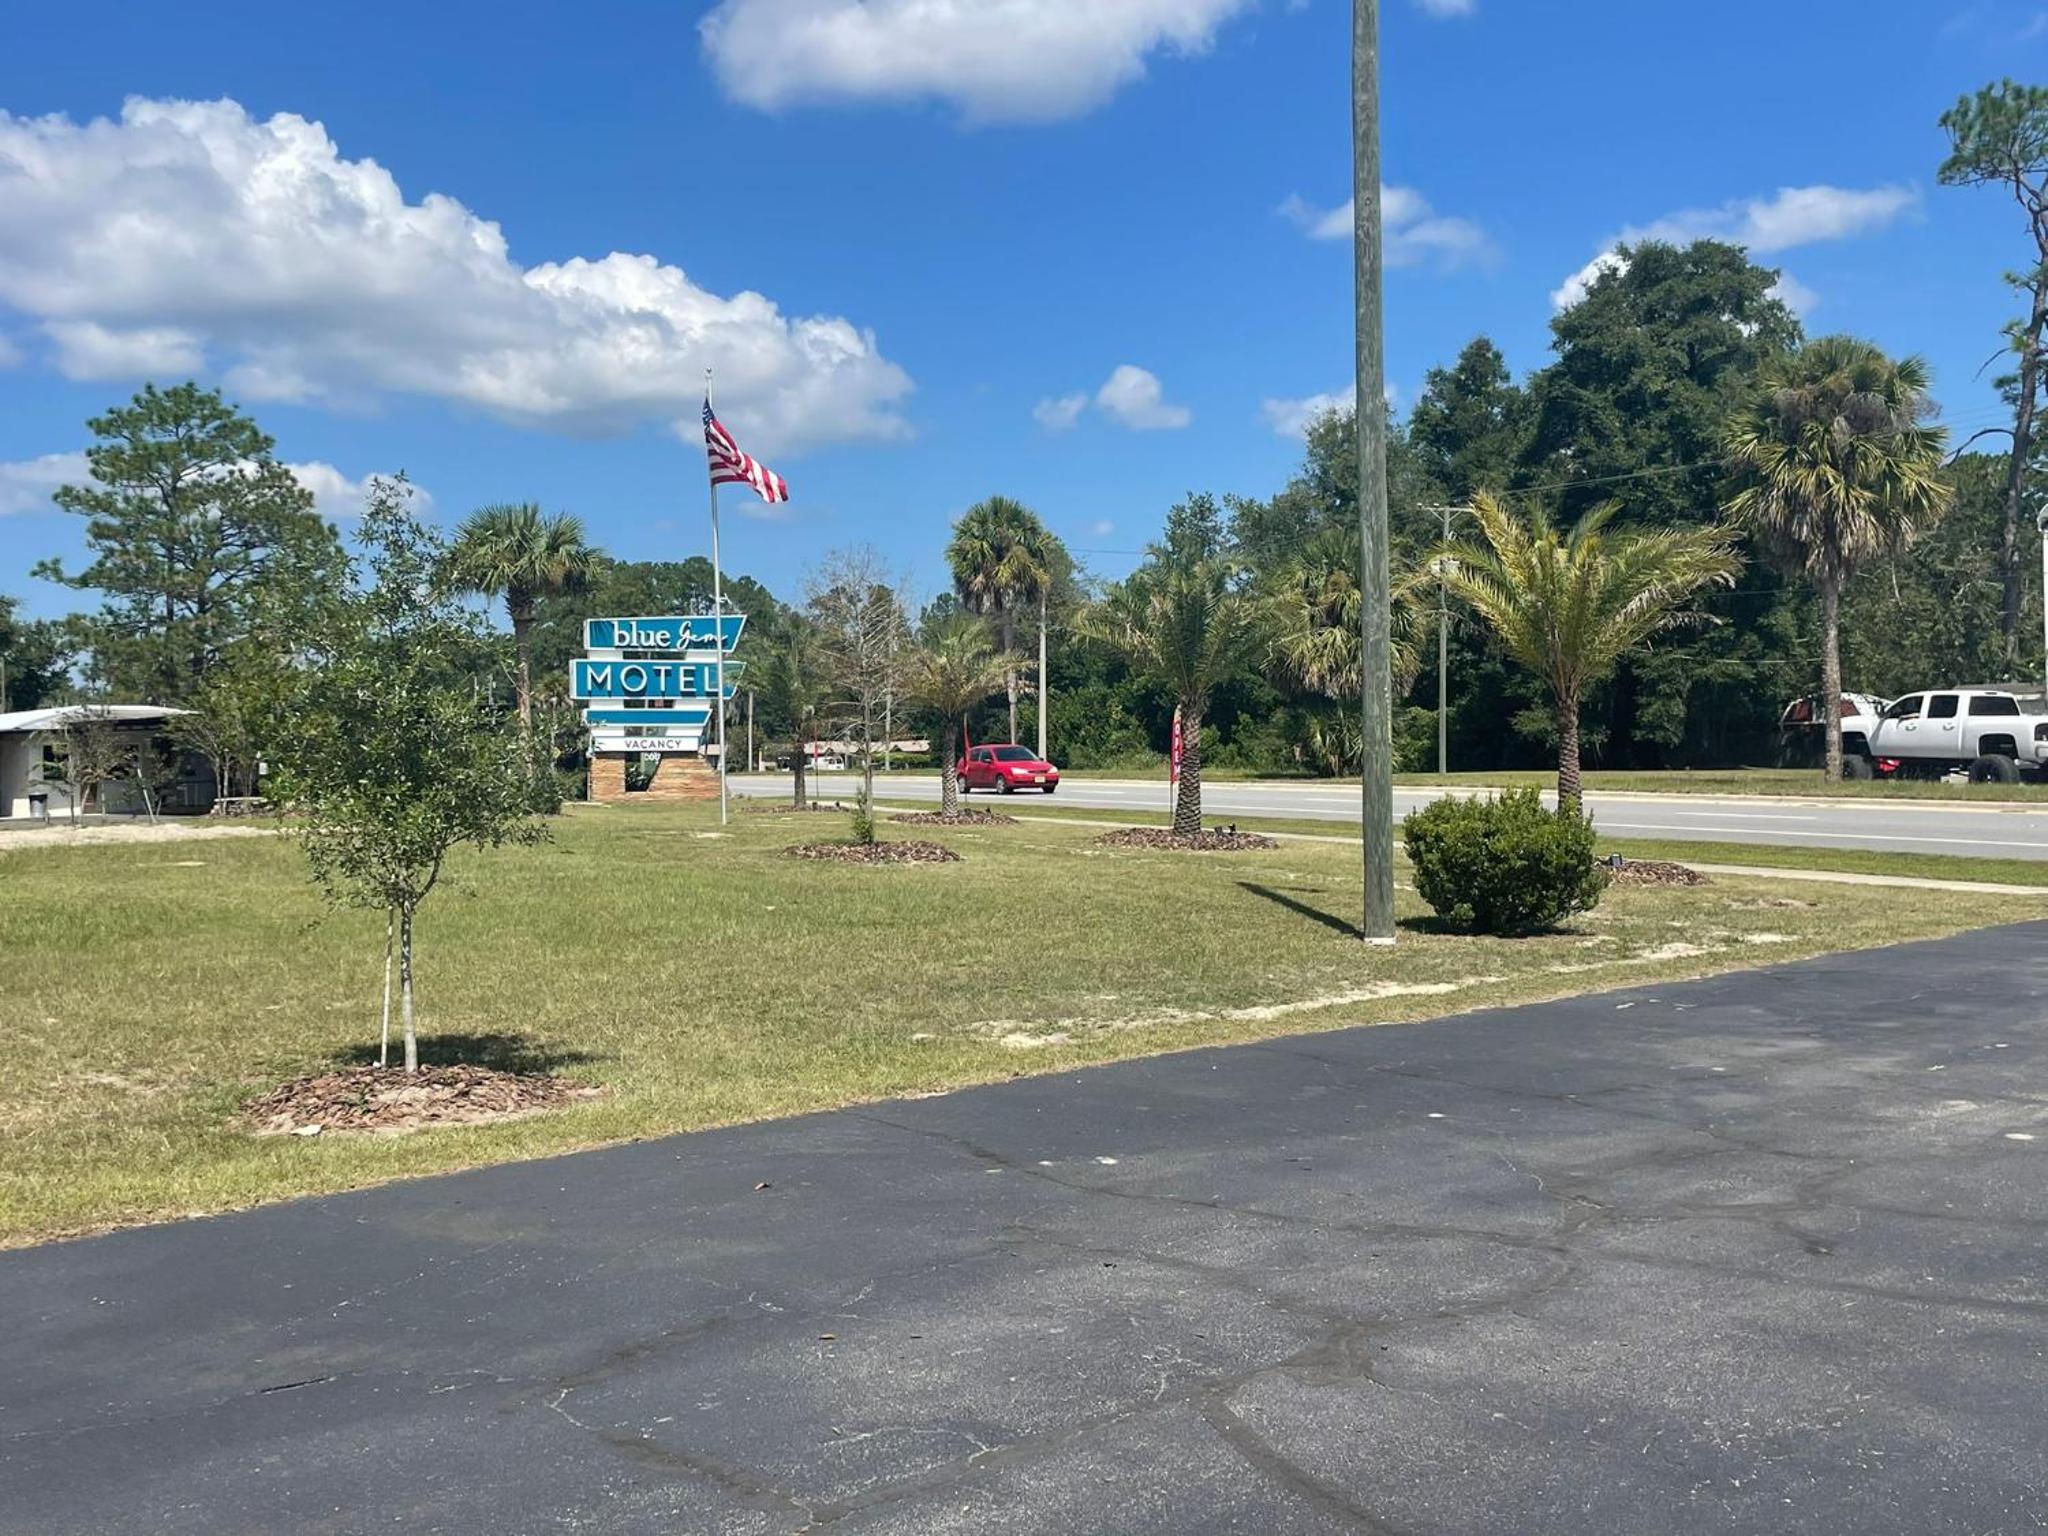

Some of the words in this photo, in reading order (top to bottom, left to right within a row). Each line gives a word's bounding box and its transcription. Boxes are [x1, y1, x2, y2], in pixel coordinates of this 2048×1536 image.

[613, 621, 671, 647] blue
[586, 664, 719, 692] MOTEL
[624, 739, 682, 749] VACANCY
